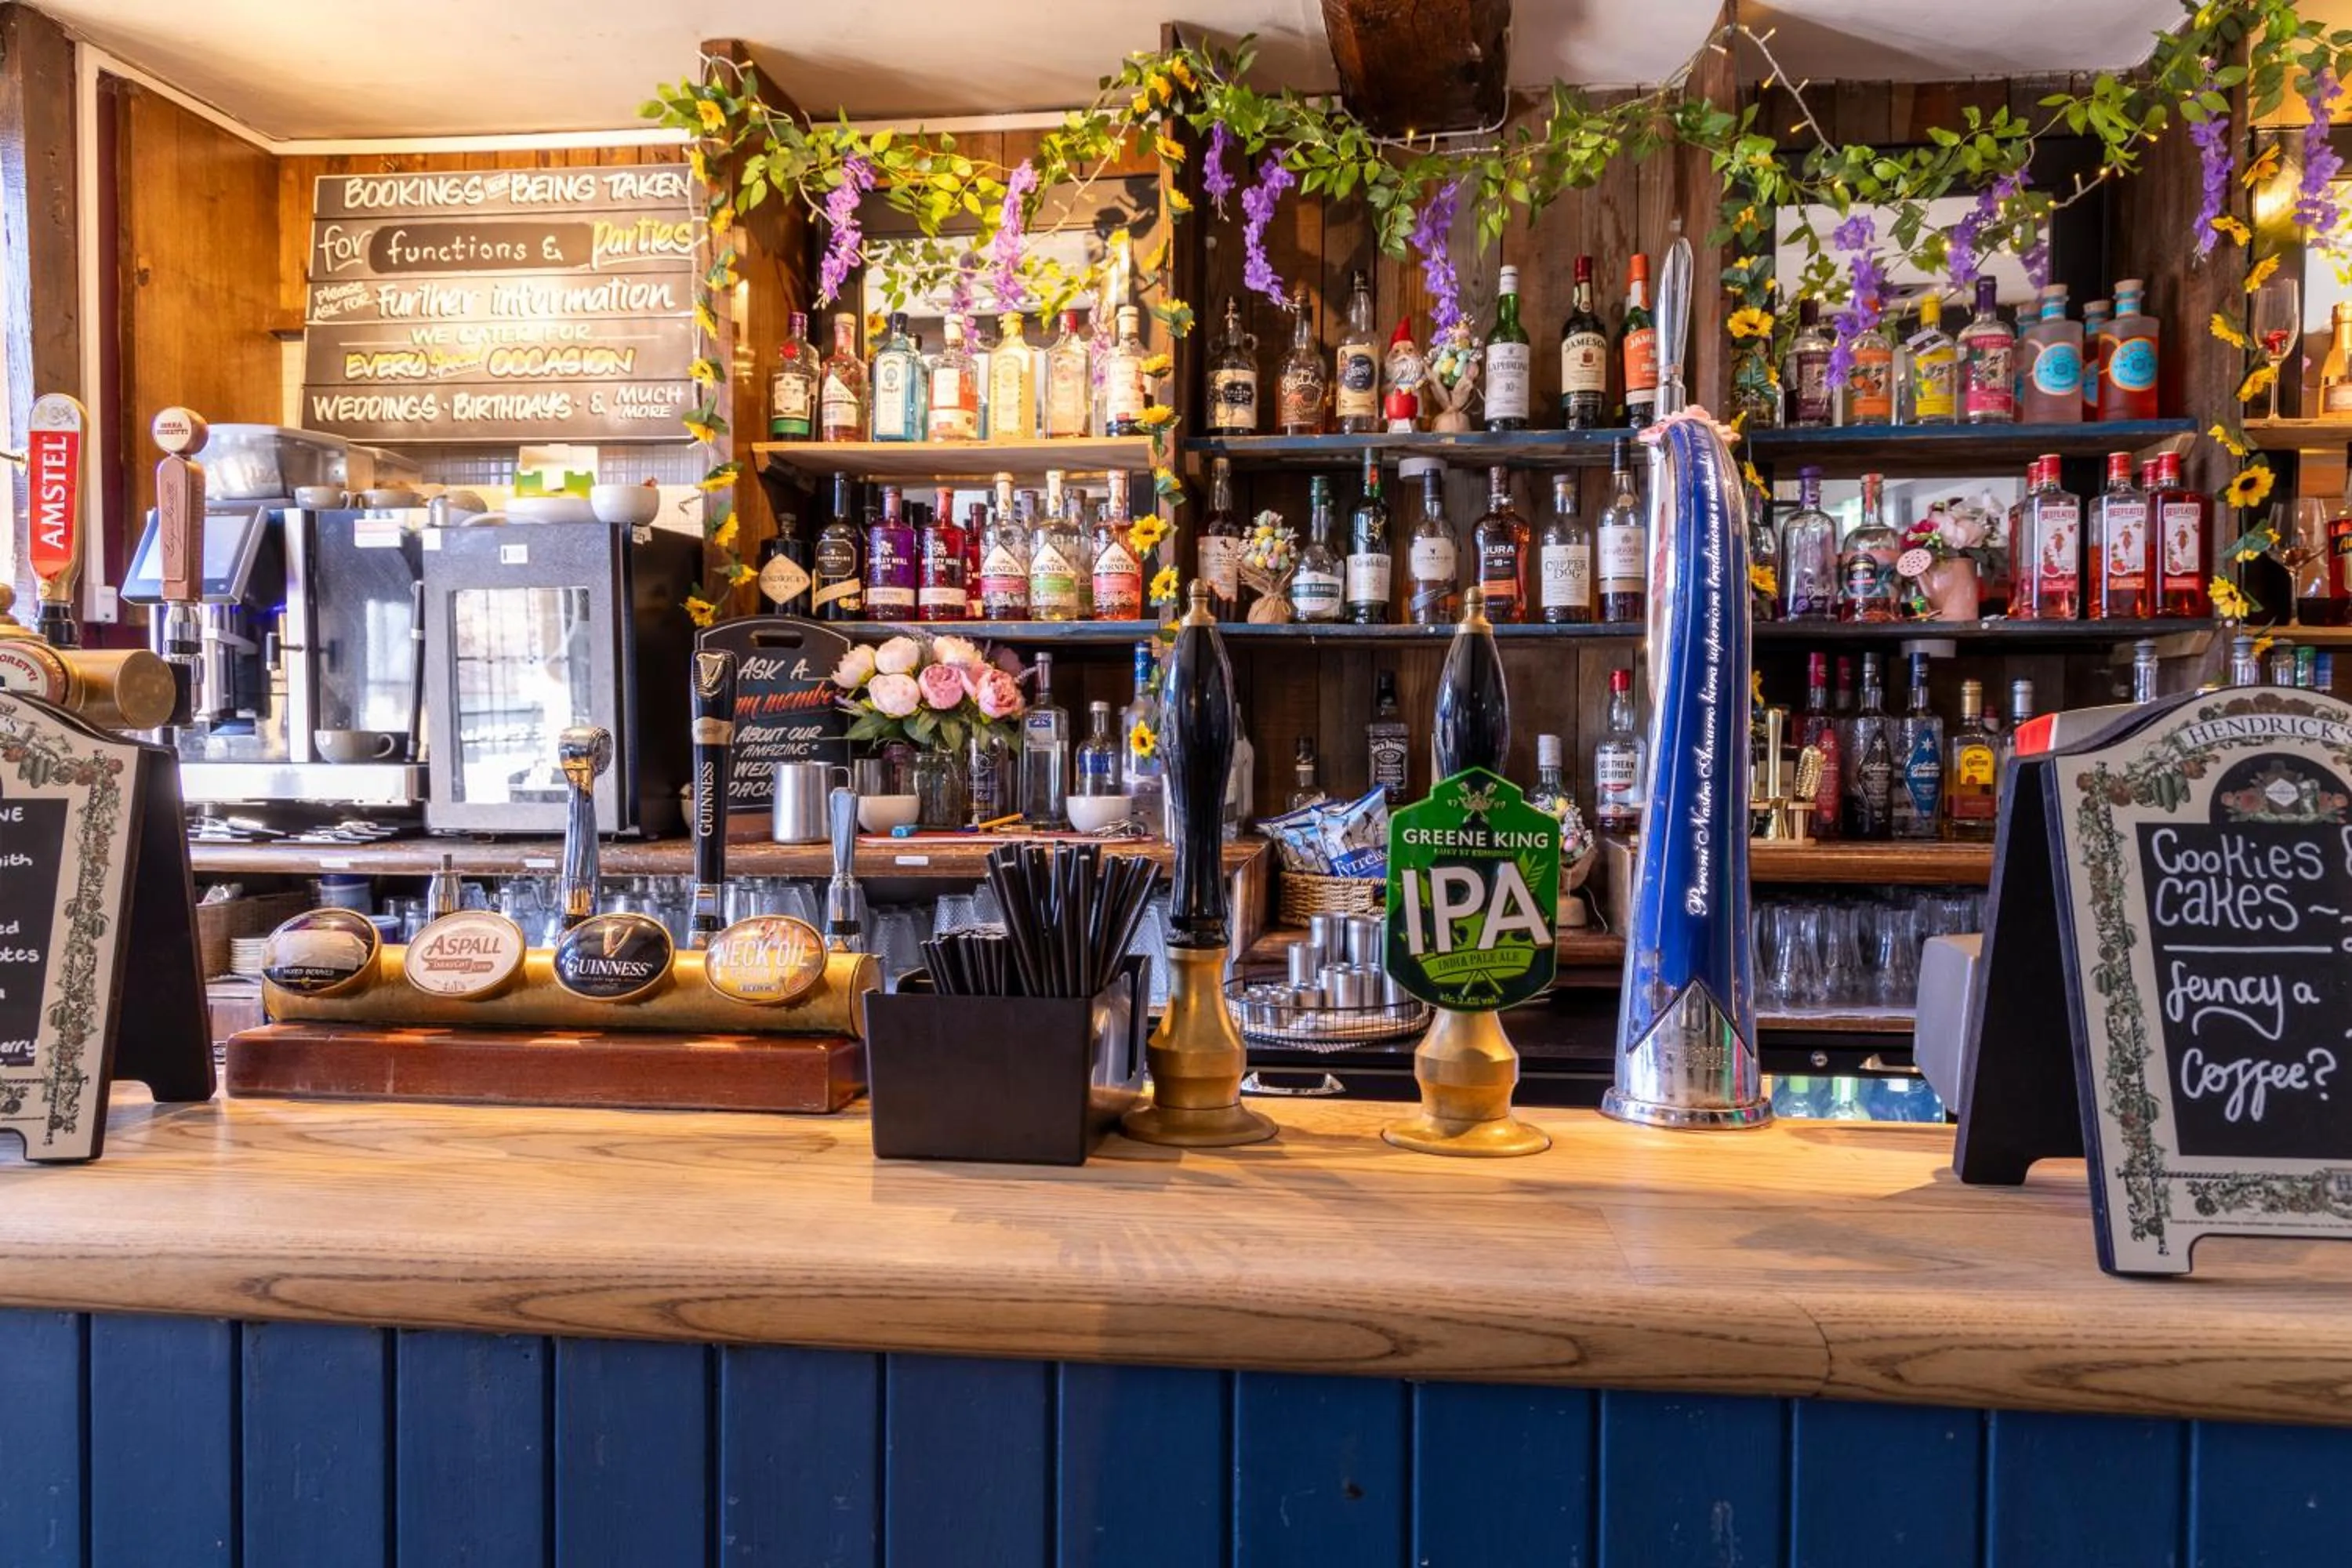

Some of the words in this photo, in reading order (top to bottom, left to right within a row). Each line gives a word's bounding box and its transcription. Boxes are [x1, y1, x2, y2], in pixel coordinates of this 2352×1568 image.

[344, 176, 485, 208] BOOKINGS
[510, 173, 595, 203] BEING
[604, 168, 691, 199] TAKEN
[318, 225, 372, 272] for
[387, 230, 527, 263] functions
[542, 235, 564, 261] &
[377, 282, 474, 318] Further
[492, 278, 675, 315] information
[410, 328, 447, 345] WE
[544, 322, 592, 341] FOR
[344, 350, 427, 379] EVERY
[488, 346, 636, 378] OCCASION
[314, 394, 439, 423] WEDDINGS
[452, 391, 572, 422] BIRTHDAYS
[590, 392, 607, 415] &
[615, 386, 683, 405] MUCH
[621, 404, 672, 419] MORE
[41, 436, 67, 549] AMSTEL
[1483, 545, 1515, 554] JURA
[1554, 569, 1581, 579] DOG
[0, 653, 38, 682] ORETTI
[738, 656, 785, 681] ASK
[790, 658, 810, 681] A
[761, 681, 834, 713] membe
[735, 725, 787, 743] ABOUT
[788, 725, 822, 740] OUR
[739, 743, 809, 758] AMAZING
[699, 761, 713, 837] GUINNESS
[1690, 780, 1713, 844] Nastro
[1402, 828, 1487, 848] GREENE
[1494, 831, 1549, 849] KING
[0, 853, 33, 867] ith
[1685, 847, 1711, 916] Peroni
[1402, 861, 1553, 956] IPA
[427, 935, 502, 956] ASPALL
[776, 939, 809, 967] OIL
[565, 956, 651, 977] GUINNESS
[2293, 982, 2321, 1004] a
[2181, 1047, 2337, 1122] Coffee?
